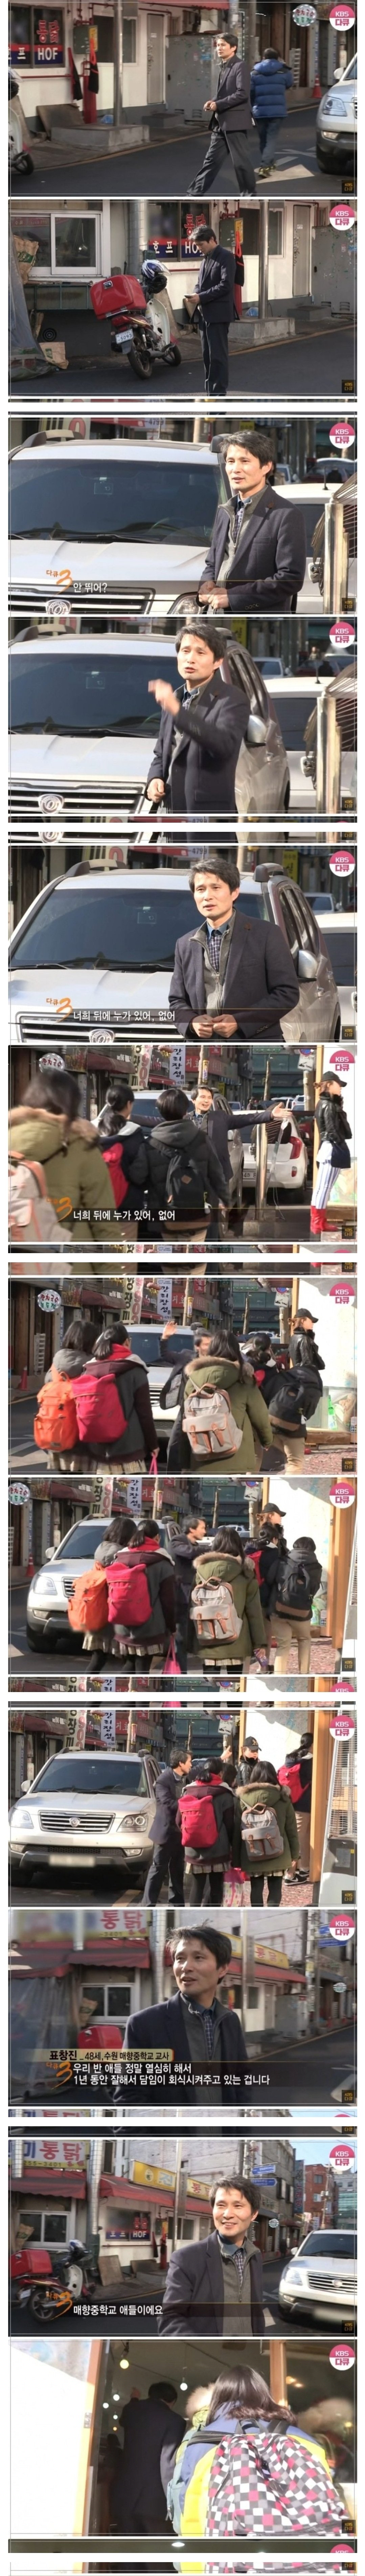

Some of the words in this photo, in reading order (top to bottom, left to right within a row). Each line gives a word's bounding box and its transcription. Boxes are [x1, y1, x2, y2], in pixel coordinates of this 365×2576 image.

[37, 20, 59, 43] 통닭
[38, 47, 58, 60] HOF
[153, 240, 173, 254] 호프
[185, 241, 204, 254] HO
[40, 1294, 59, 1303] 잔치국수
[100, 1909, 143, 1930] 통닭
[39, 2140, 82, 2161] 통닭
